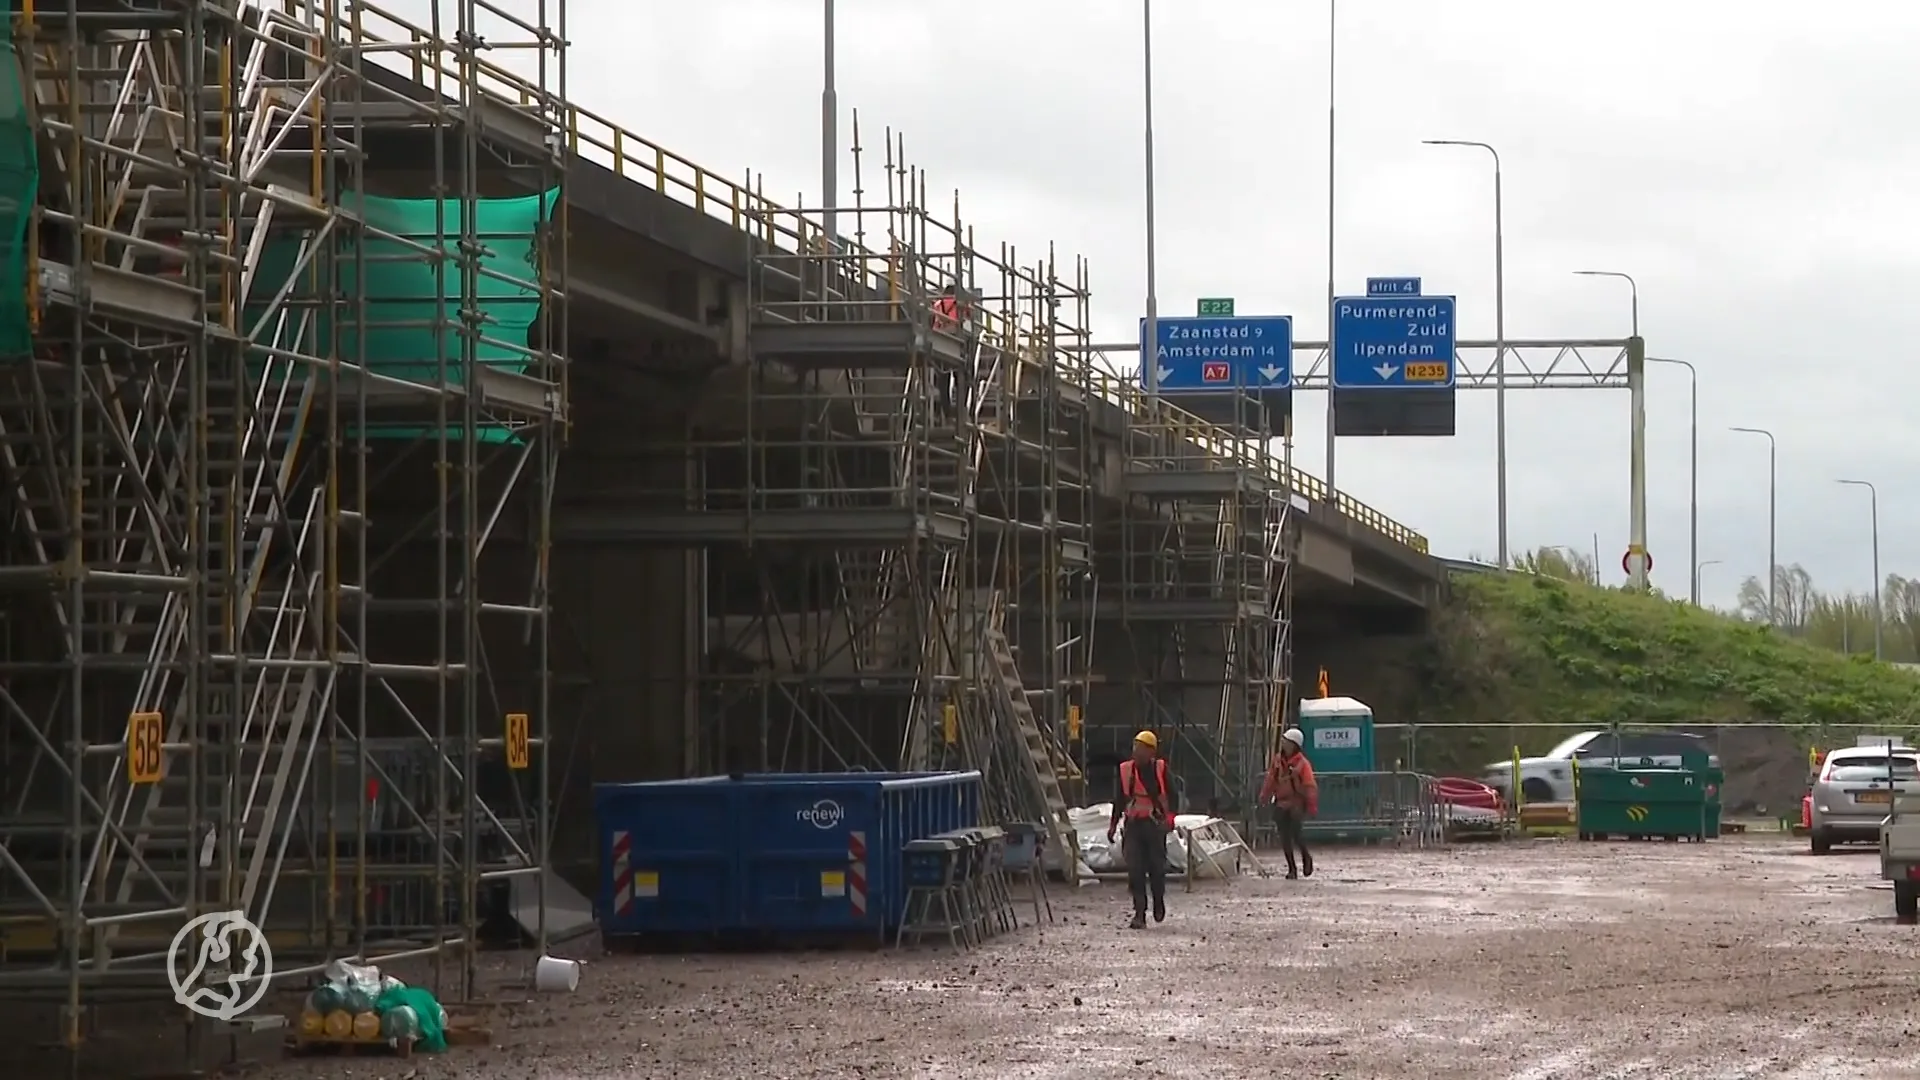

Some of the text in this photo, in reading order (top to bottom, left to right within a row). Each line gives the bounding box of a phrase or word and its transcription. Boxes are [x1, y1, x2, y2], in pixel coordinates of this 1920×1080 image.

[1371, 281, 1413, 292] afrit 4
[1200, 302, 1231, 313] E22
[1340, 305, 1447, 318] Purmerend-
[1169, 325, 1263, 339] Zaanstad 9
[1407, 323, 1447, 336] Zuid
[1157, 344, 1275, 357] Amsterdam 14
[1354, 342, 1434, 358] Ilpendam
[1205, 367, 1227, 378] A7
[1406, 367, 1445, 377] N235
[510, 718, 527, 762] 5A
[134, 719, 160, 776] 5B
[796, 804, 845, 821] renewi
